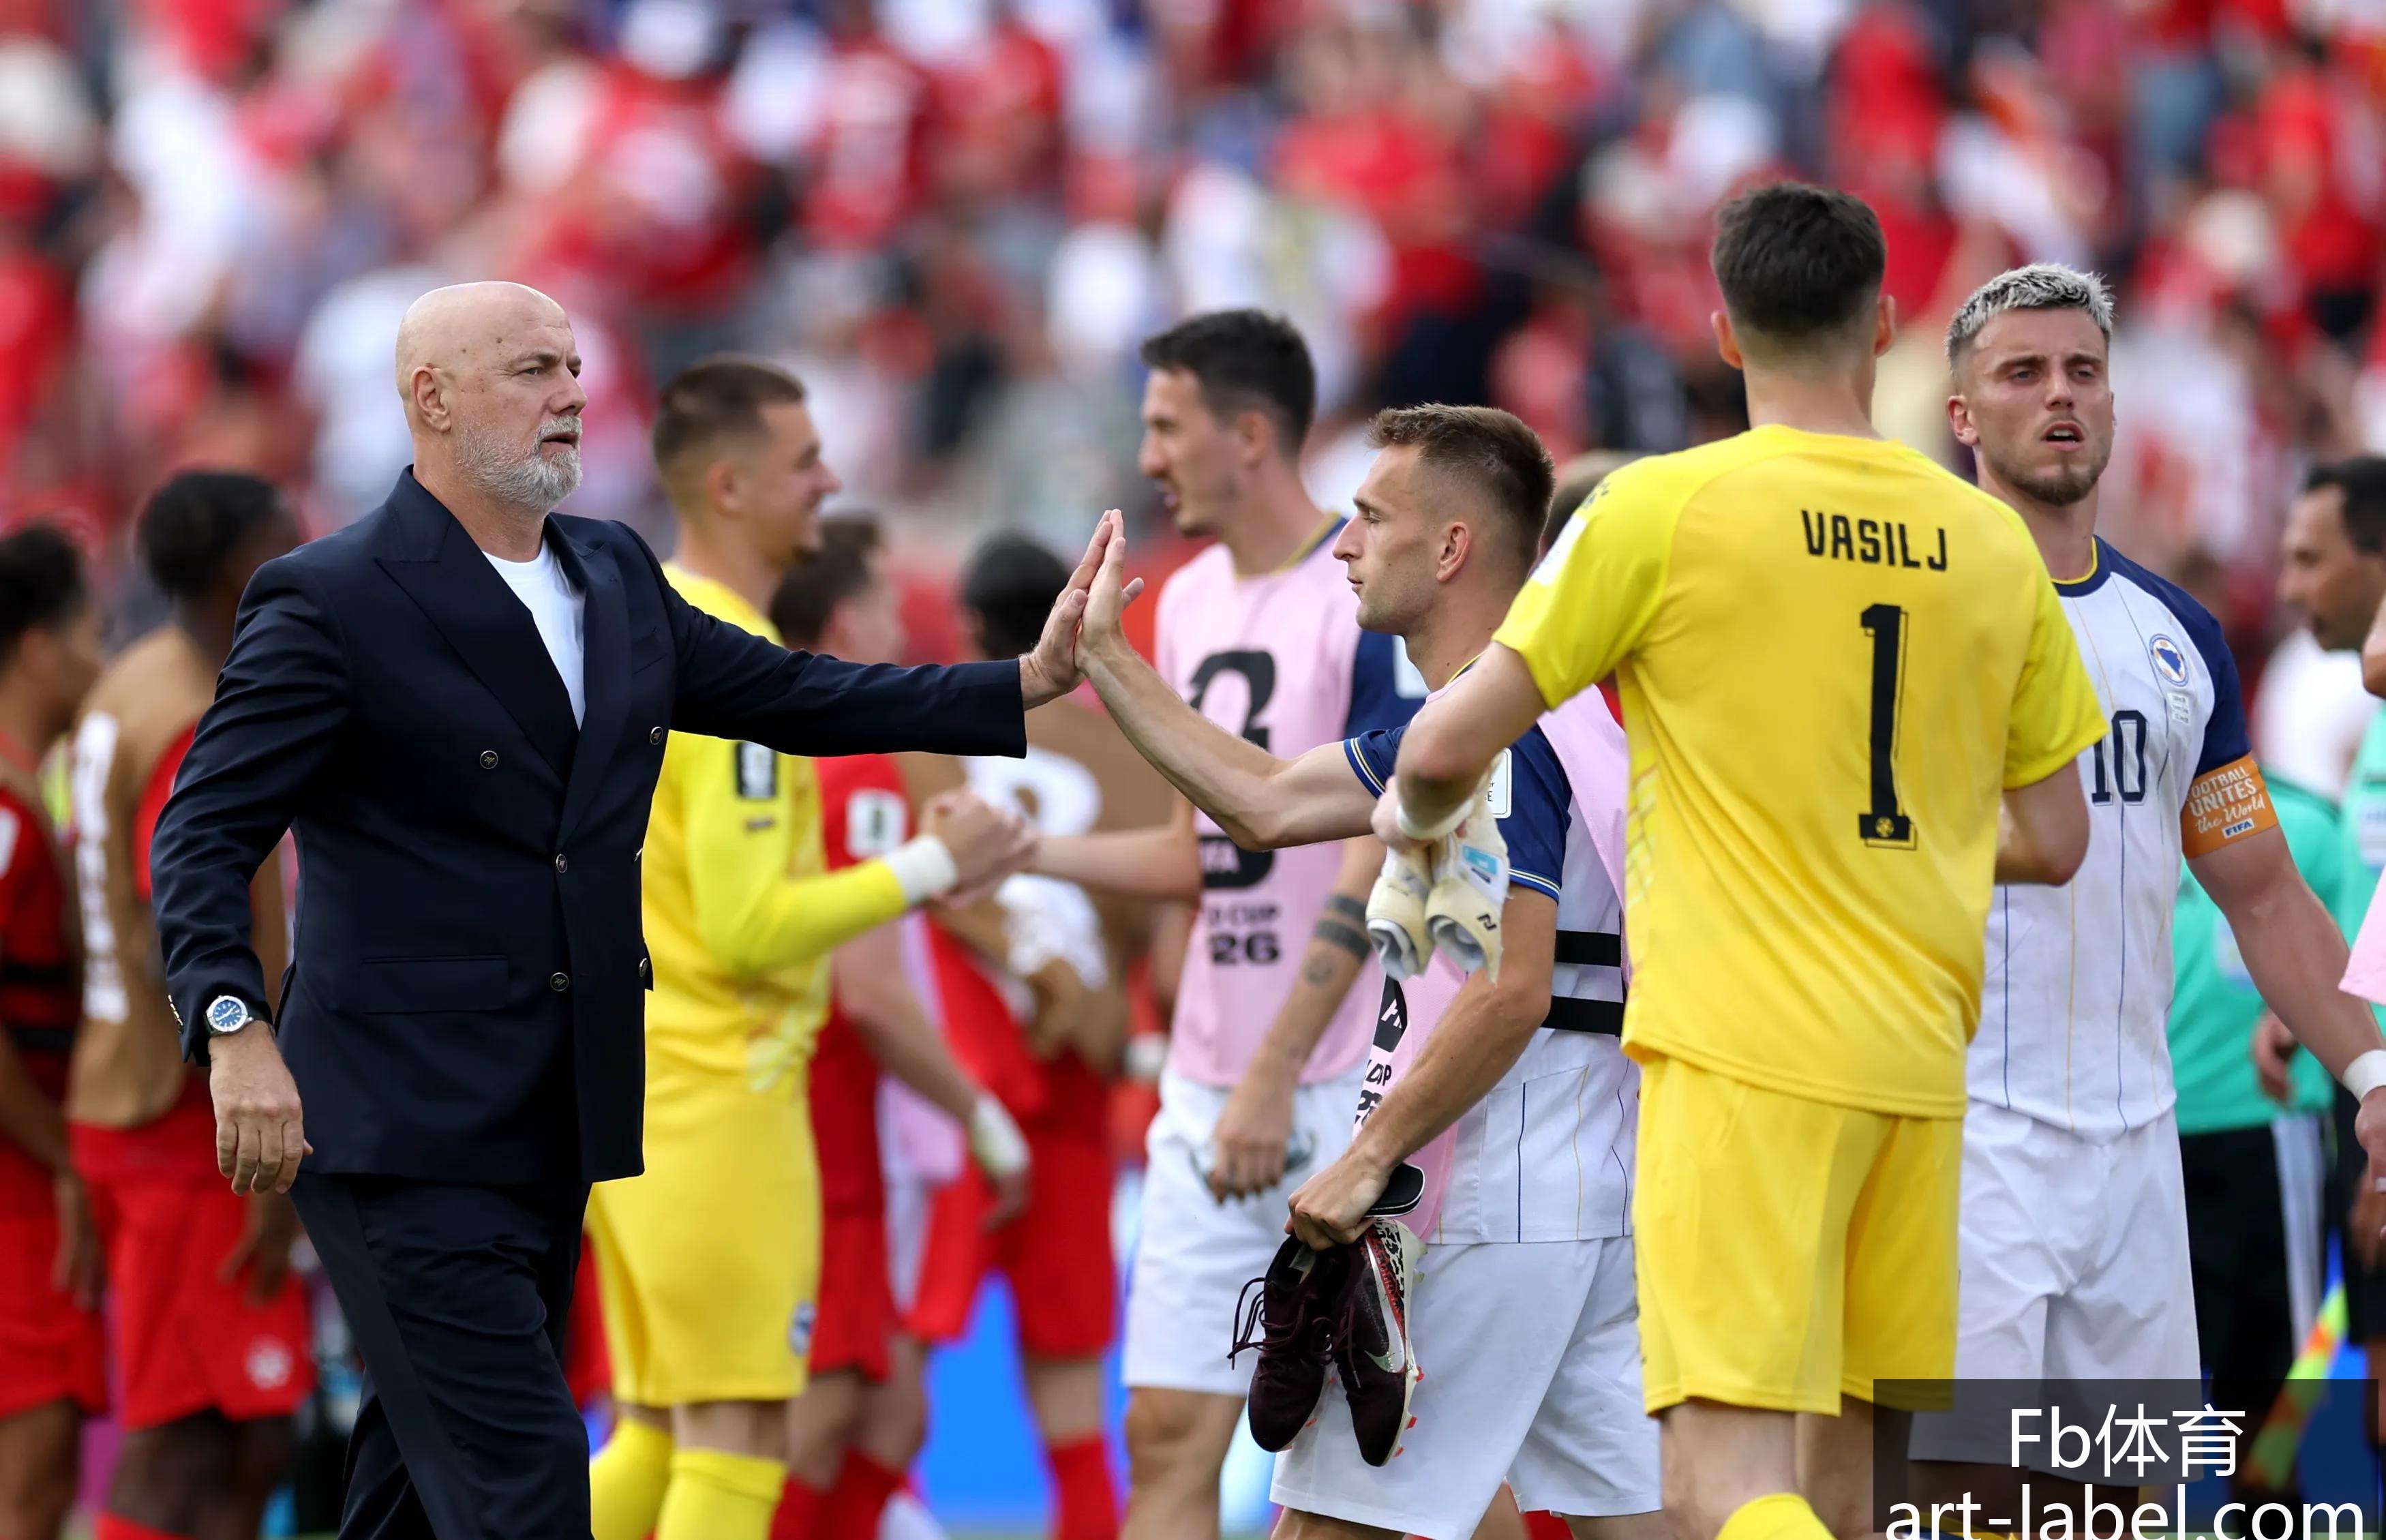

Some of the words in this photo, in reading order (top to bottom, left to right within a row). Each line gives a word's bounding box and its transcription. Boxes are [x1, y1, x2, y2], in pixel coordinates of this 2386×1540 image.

[1801, 510, 1948, 572] VASILJ
[1858, 603, 1916, 850] 1
[2091, 710, 2150, 806] 10
[2188, 766, 2250, 800] OOTBALL
[2189, 778, 2257, 817] UNITES
[2195, 816, 2222, 834] the
[2223, 794, 2265, 823] World
[2224, 820, 2252, 836] FIFA
